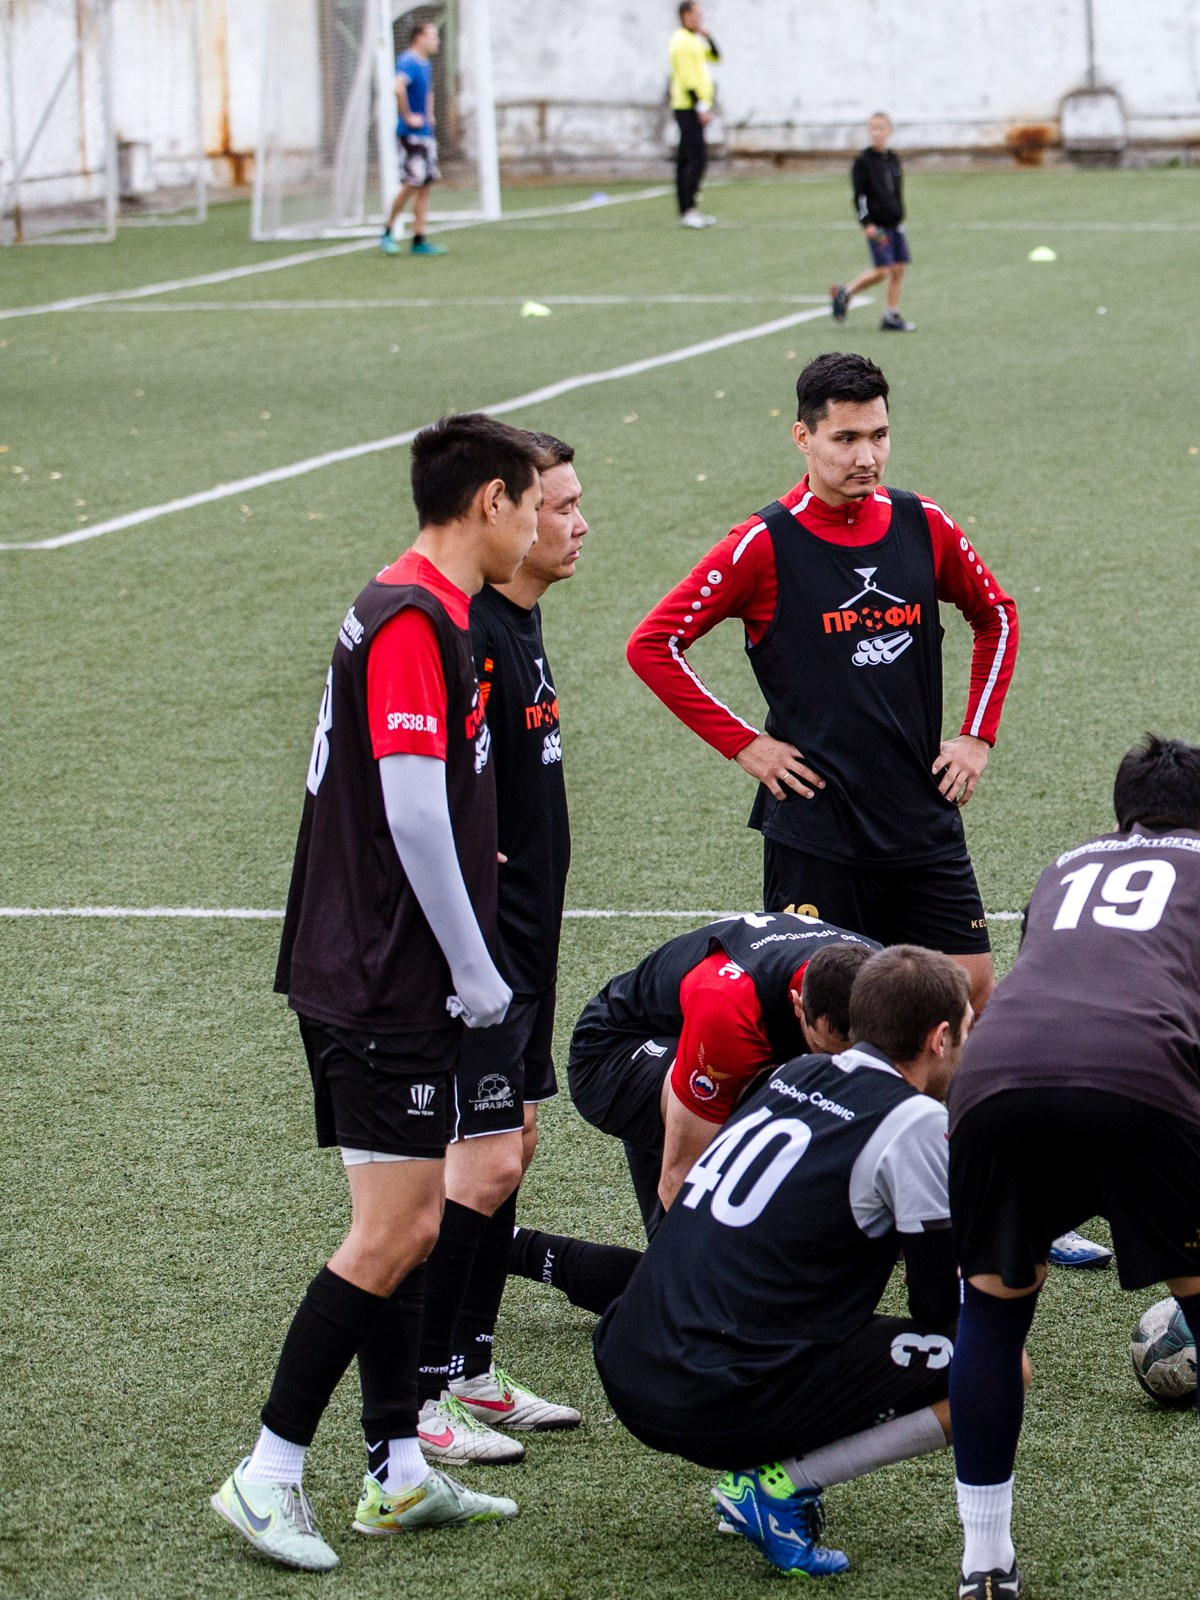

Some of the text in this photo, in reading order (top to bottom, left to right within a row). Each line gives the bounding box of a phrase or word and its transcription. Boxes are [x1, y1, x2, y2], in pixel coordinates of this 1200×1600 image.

[387, 711, 438, 735] SPS38.RU
[1052, 859, 1177, 932] 19
[682, 1106, 812, 1228] 40
